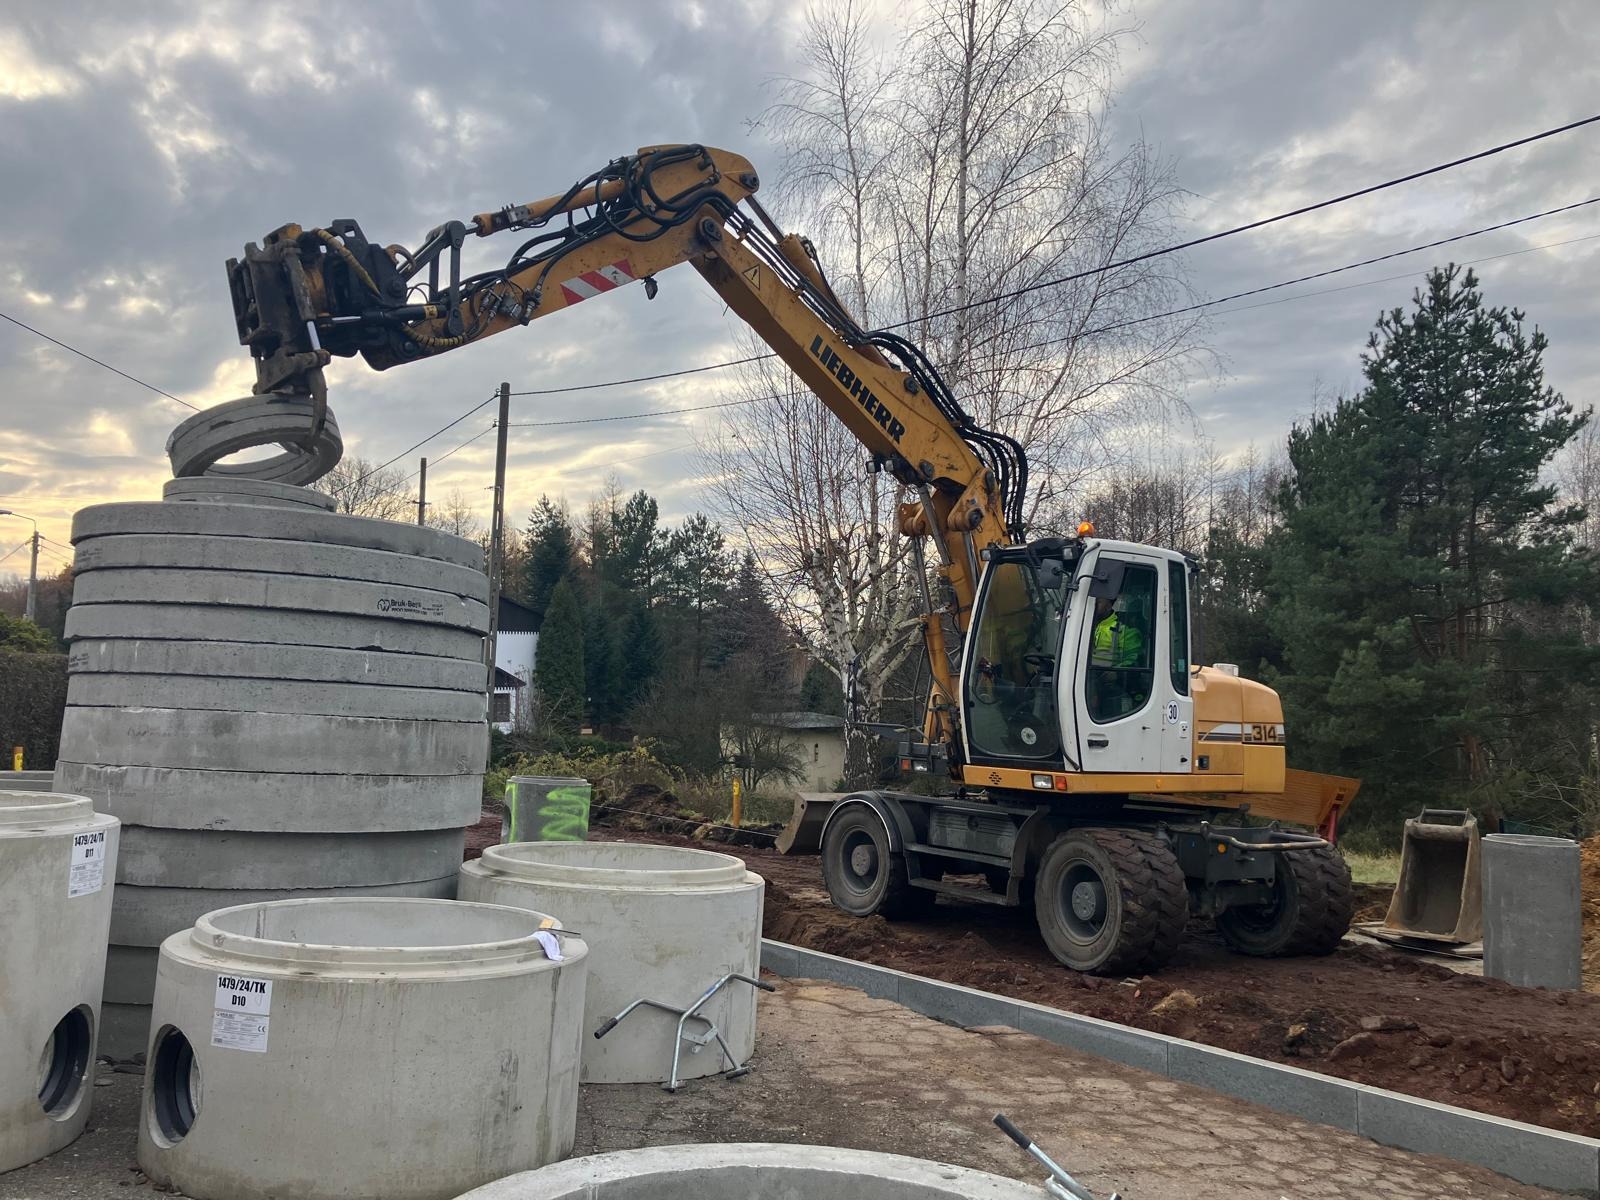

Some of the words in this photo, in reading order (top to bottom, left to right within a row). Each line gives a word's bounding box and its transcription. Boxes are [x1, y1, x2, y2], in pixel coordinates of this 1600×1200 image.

[810, 334, 906, 444] LIEBHERR
[1168, 704, 1178, 720] 30
[1252, 725, 1277, 741] 314
[74, 832, 104, 847] 1479/24/TK
[85, 848, 94, 858] D11
[218, 976, 266, 994] 1479/24/TK
[231, 994, 246, 1007] D10
